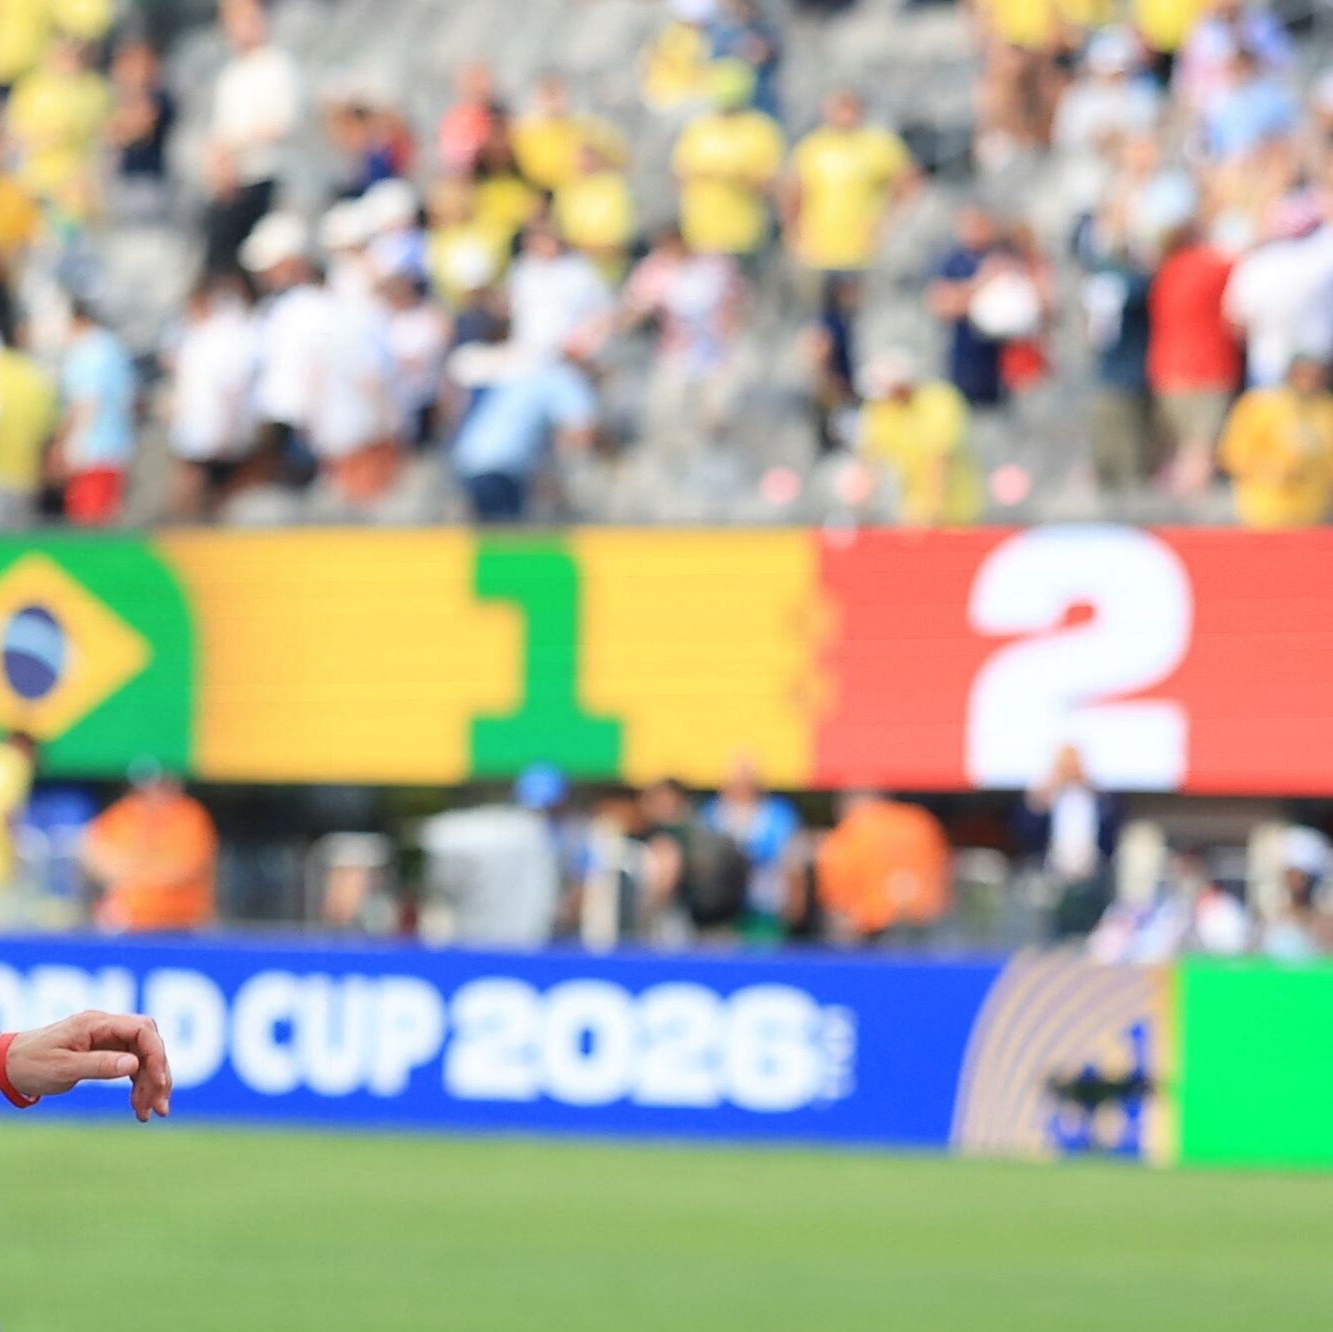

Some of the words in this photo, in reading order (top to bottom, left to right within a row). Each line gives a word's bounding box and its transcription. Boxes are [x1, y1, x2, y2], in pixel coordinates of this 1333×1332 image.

[467, 545, 623, 776] 1
[967, 522, 1193, 790] 2
[235, 970, 445, 1097] CUP
[442, 975, 825, 1113] 2026
